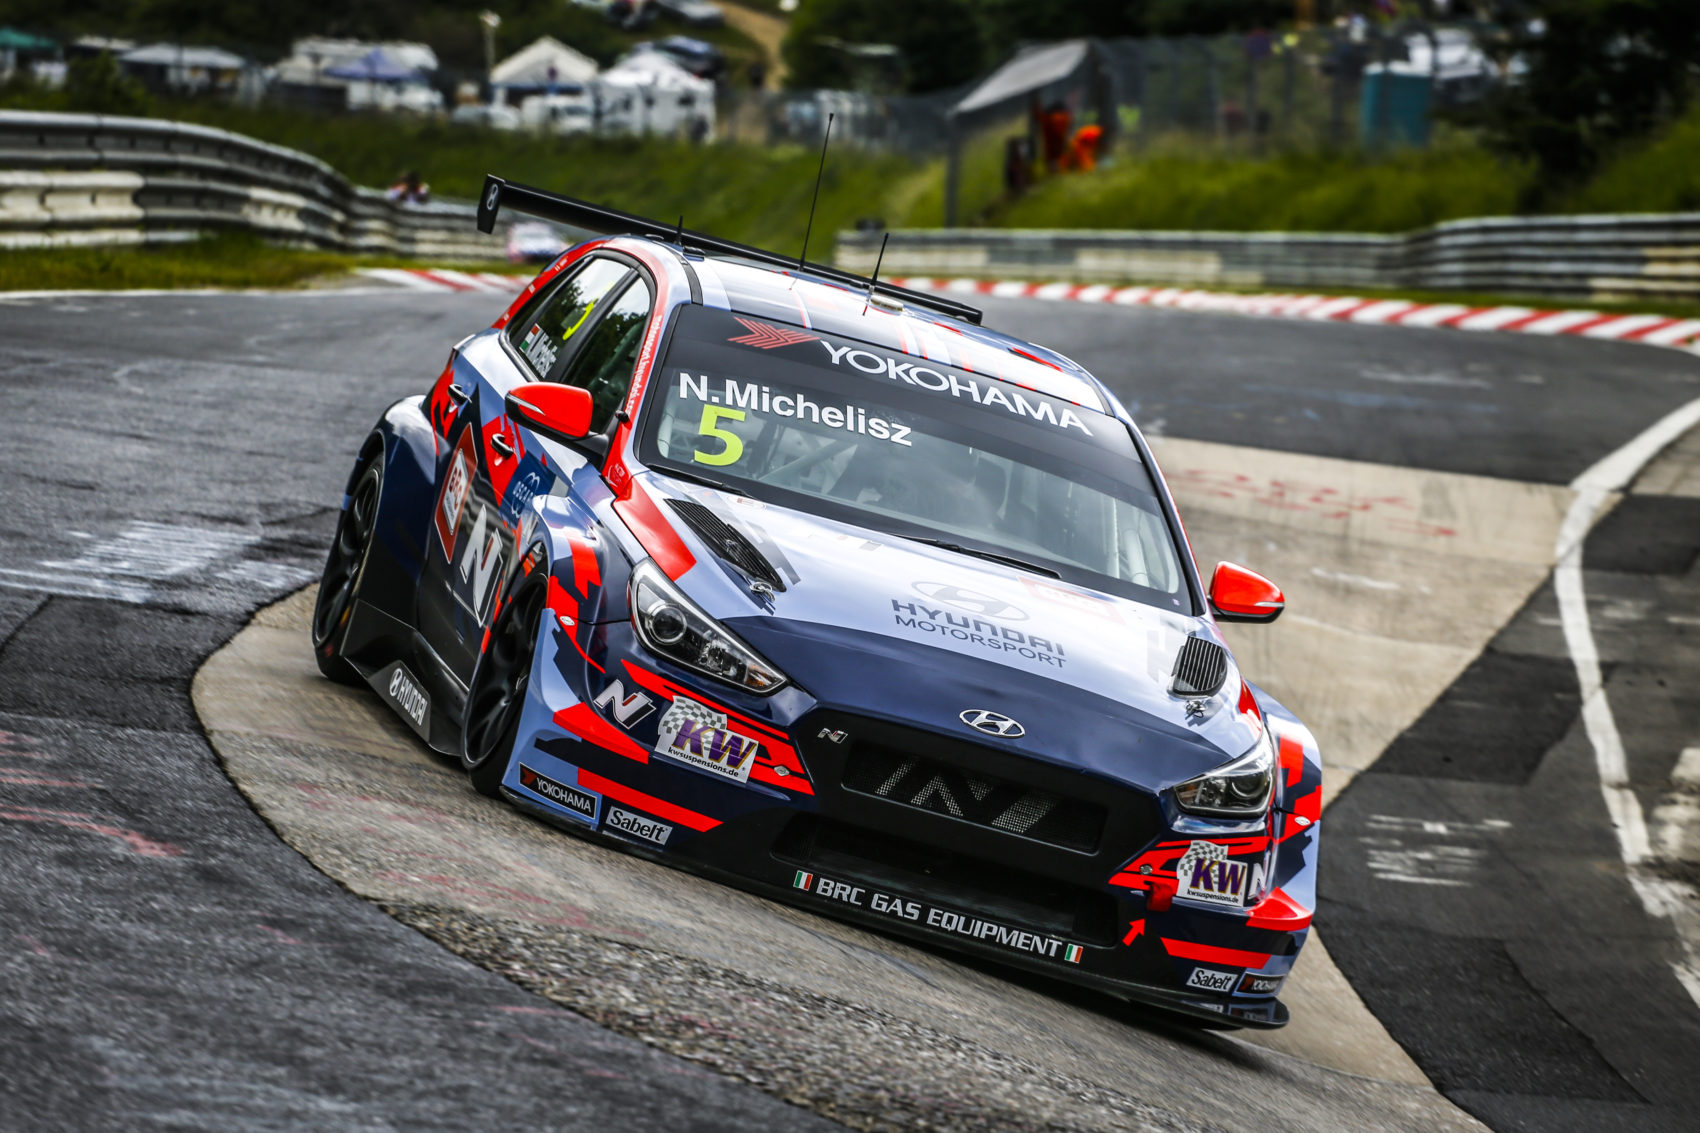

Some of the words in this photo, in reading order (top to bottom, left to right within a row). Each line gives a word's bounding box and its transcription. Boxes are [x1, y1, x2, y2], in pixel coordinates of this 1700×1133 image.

[679, 372, 912, 447] N.Michelisz
[820, 340, 1093, 437] YOKOHAMA
[694, 403, 746, 466] 5
[891, 598, 1066, 657] HYUNDAI
[895, 614, 1067, 668] MOTORSPORT
[396, 675, 428, 727] HYUNDAI
[667, 746, 739, 778] kwsuspensions.de
[672, 717, 758, 770] KW
[536, 777, 592, 814] YOKOHAMA
[610, 809, 667, 842] Sabelt
[1186, 888, 1240, 904] kwsuspensions.de
[1190, 857, 1247, 897] KW
[816, 877, 866, 906] BRC
[870, 893, 922, 921] GAS
[926, 909, 1063, 958] EQUIPMENT
[1191, 969, 1233, 991] Sabelt
